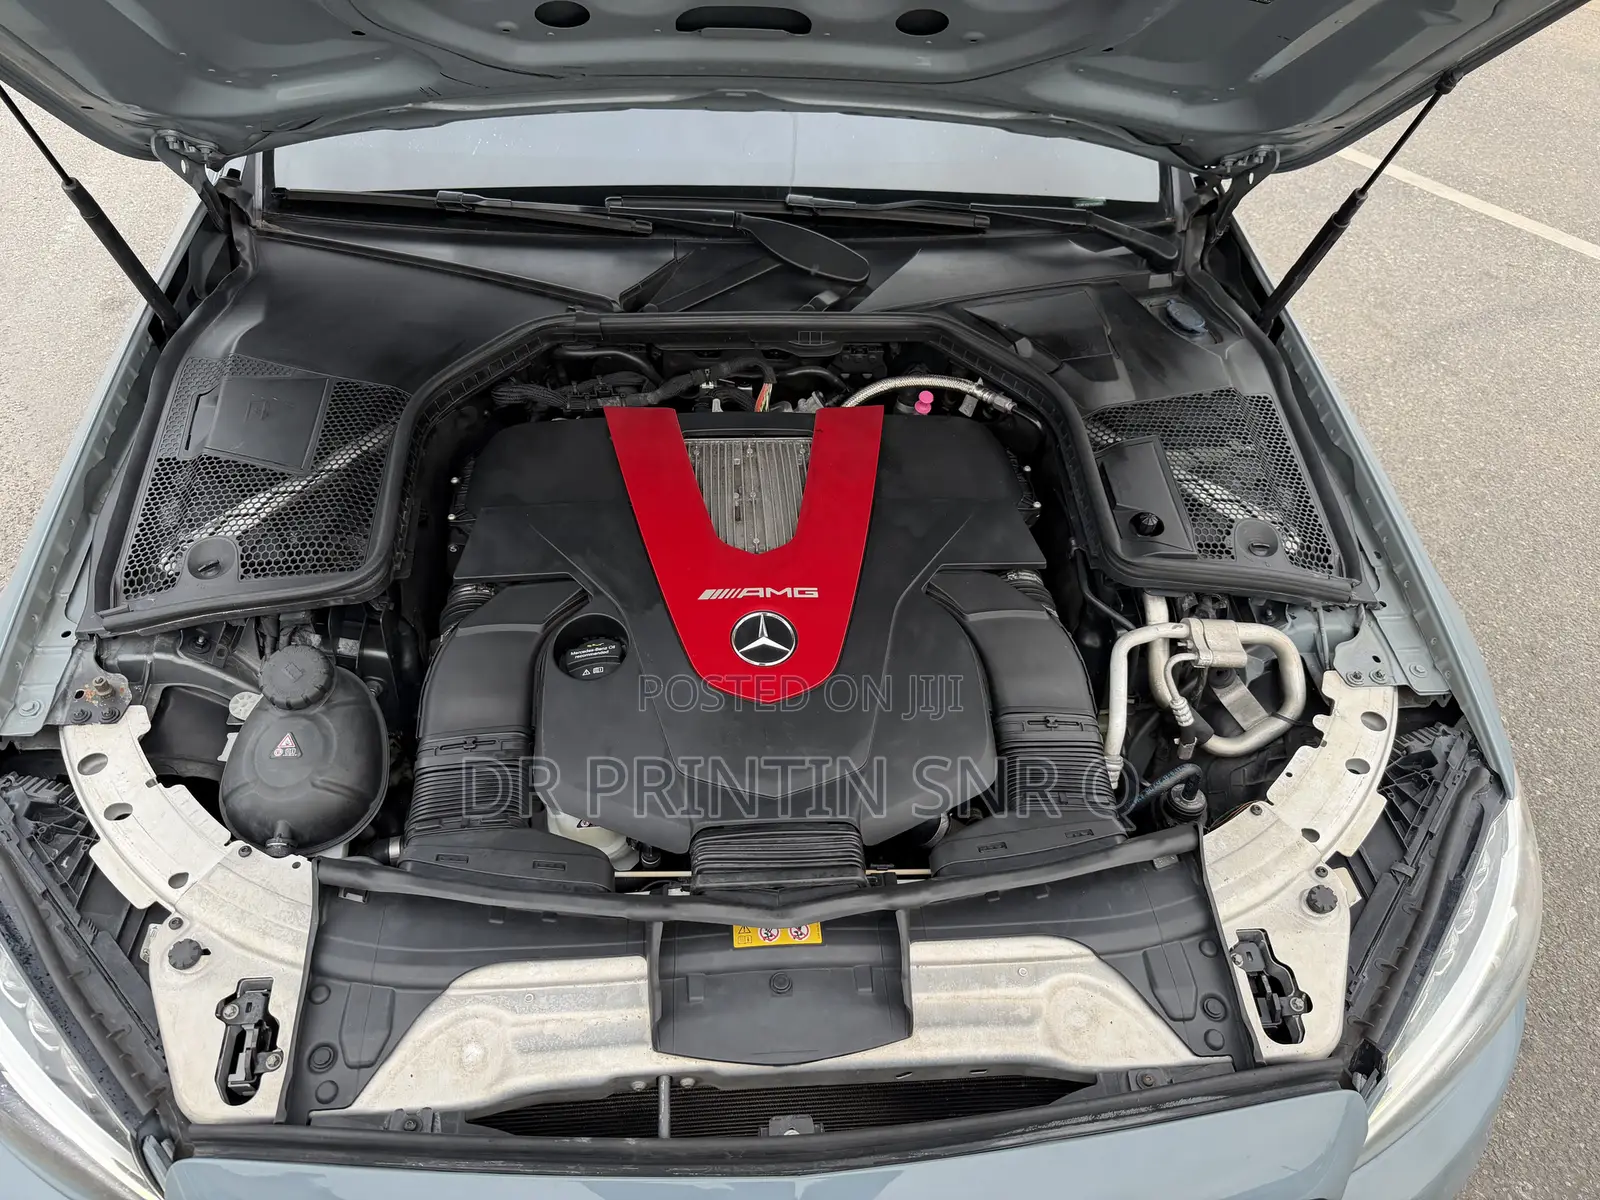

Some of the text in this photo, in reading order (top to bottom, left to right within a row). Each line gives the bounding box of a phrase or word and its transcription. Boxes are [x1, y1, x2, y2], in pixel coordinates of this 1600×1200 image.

[737, 587, 819, 599] AMG
[570, 646, 608, 656] Mercedes-Benz
[574, 650, 610, 658] recommended
